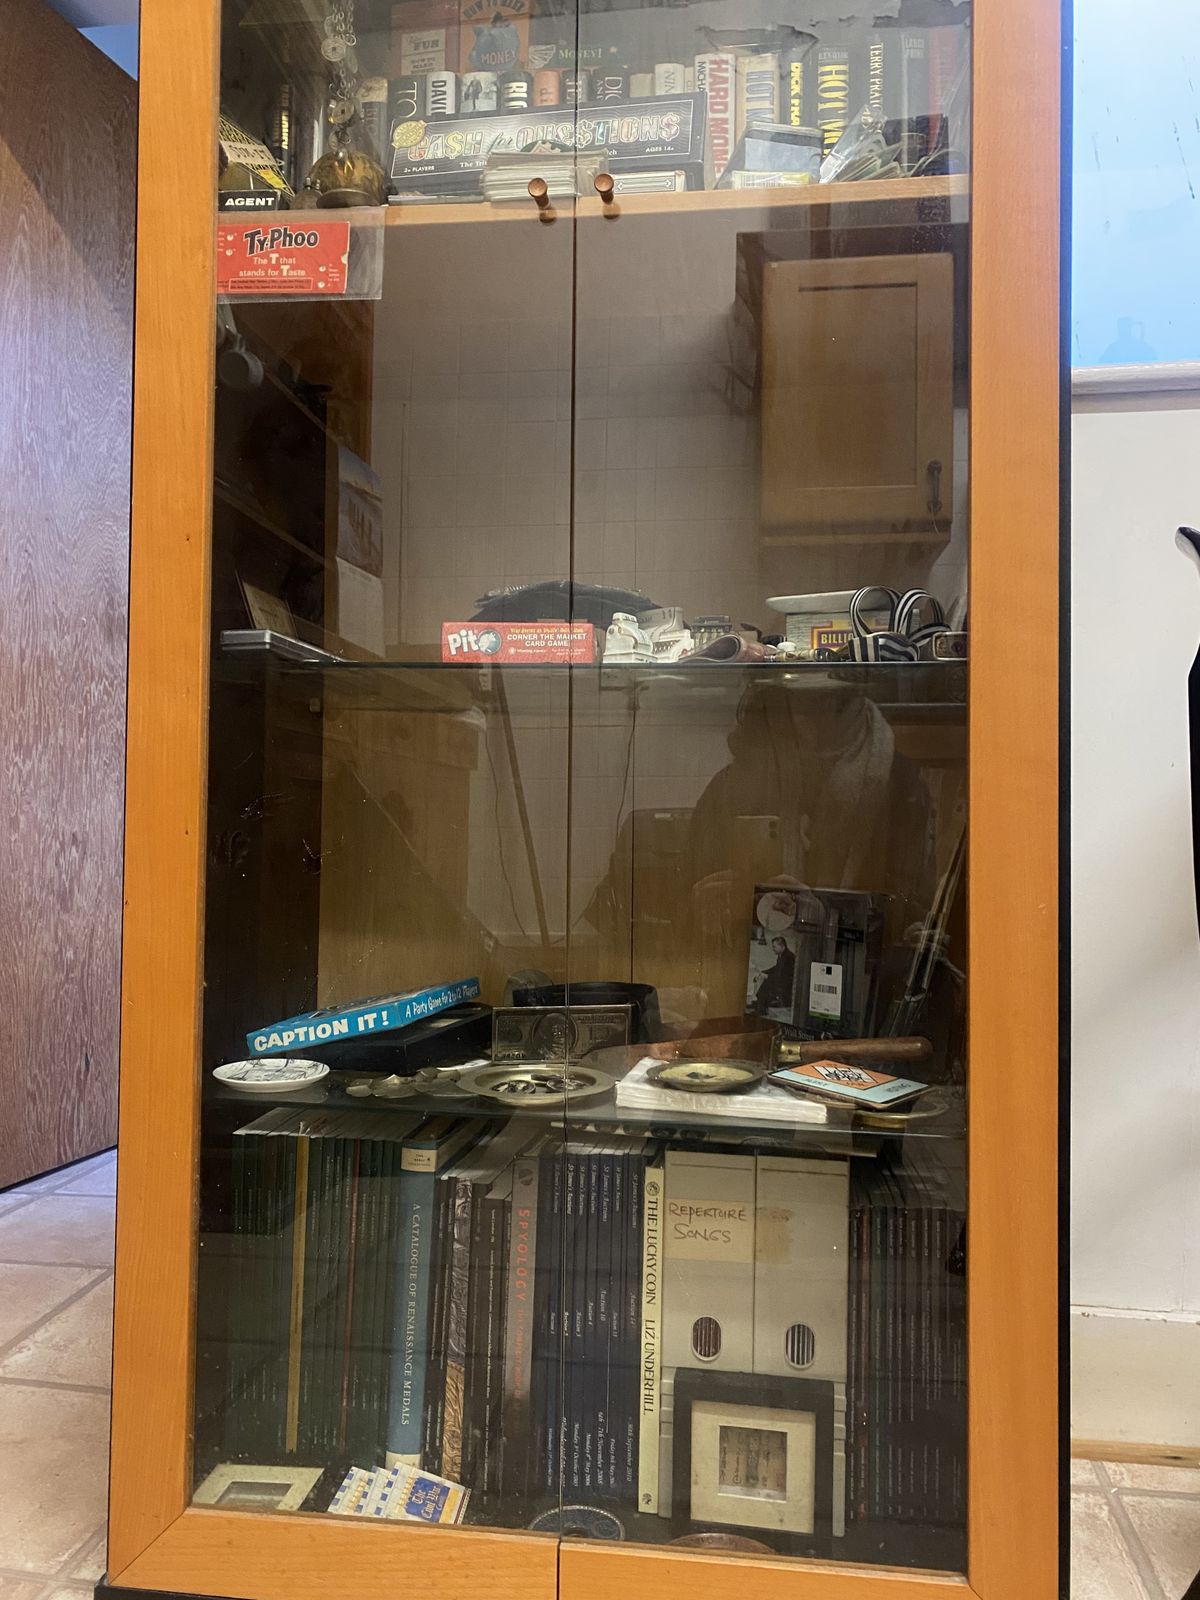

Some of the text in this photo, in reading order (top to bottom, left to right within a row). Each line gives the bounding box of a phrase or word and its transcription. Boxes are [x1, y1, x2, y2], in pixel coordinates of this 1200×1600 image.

[481, 49, 517, 66] MONEY
[870, 42, 884, 75] TERRY
[709, 58, 730, 114] HARD
[790, 62, 804, 96] DICK
[817, 64, 849, 114] HOT
[431, 80, 447, 115] DAVI
[225, 198, 274, 206] AGENT
[239, 265, 306, 277] stands for Taste
[253, 253, 296, 265] The T that
[405, 1004, 412, 1018] A
[413, 1001, 428, 1015] Party
[428, 996, 442, 1010] Game
[254, 1019, 349, 1052] CAPTION
[668, 1202, 747, 1222] REPERTOIRE
[409, 1214, 421, 1279] CATALOGUE
[515, 1208, 530, 1301] SPYOLOGY
[408, 1283, 417, 1298] OF
[643, 1198, 658, 1414] THE LUCKY COIN LIZ UNDERHILL
[404, 1301, 416, 1377] RENAISSANCE
[401, 1380, 412, 1425] MEDALS
